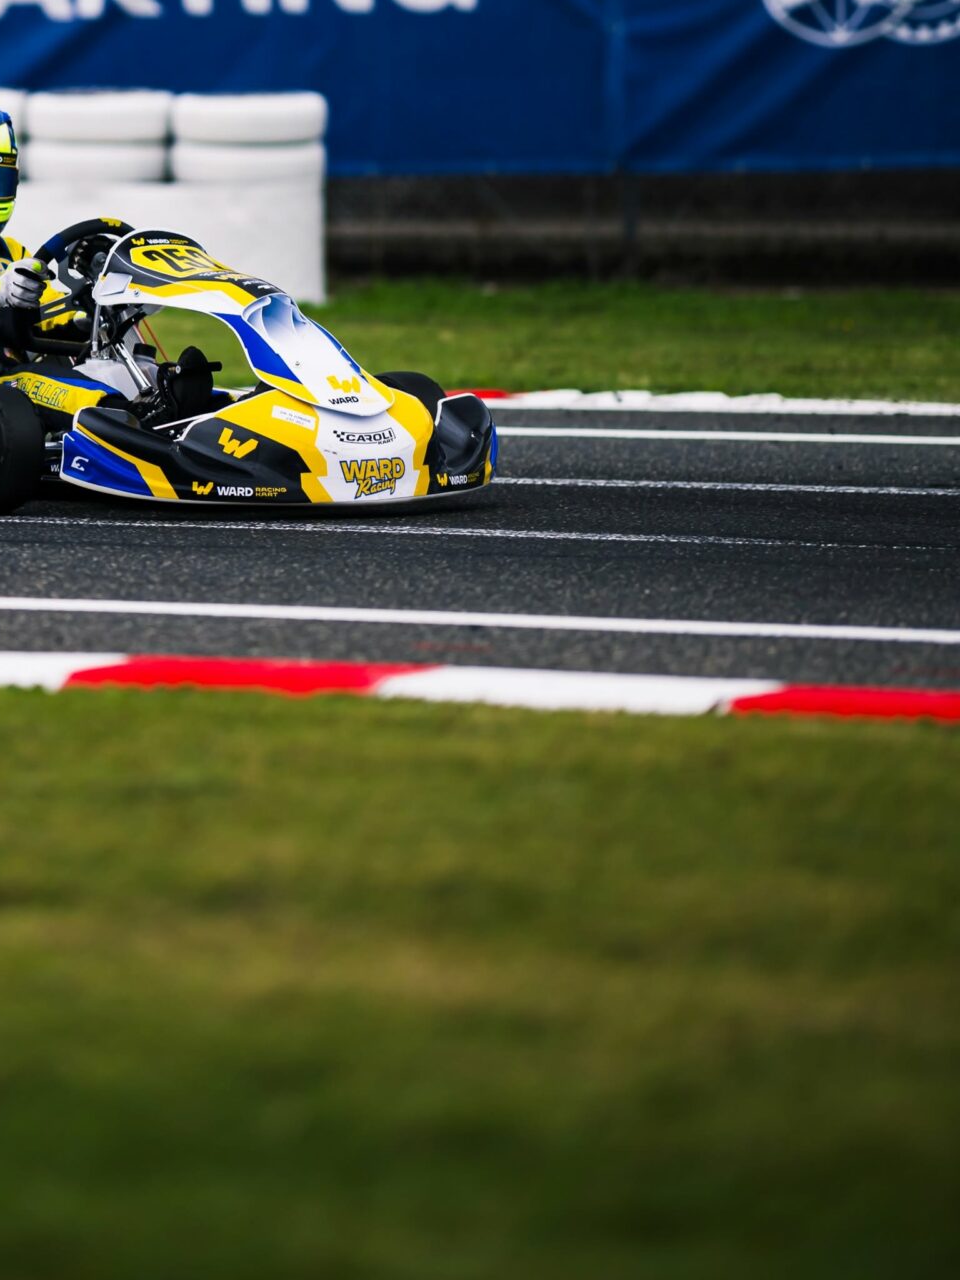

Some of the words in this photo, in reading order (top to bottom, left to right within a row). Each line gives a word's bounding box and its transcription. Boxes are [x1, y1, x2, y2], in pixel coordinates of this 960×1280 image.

[327, 395, 360, 406] WARD
[345, 429, 395, 442] CAROLI
[339, 457, 406, 484] WARD
[448, 474, 468, 486] WARD
[217, 485, 254, 498] WARD
[354, 477, 398, 500] Racing
